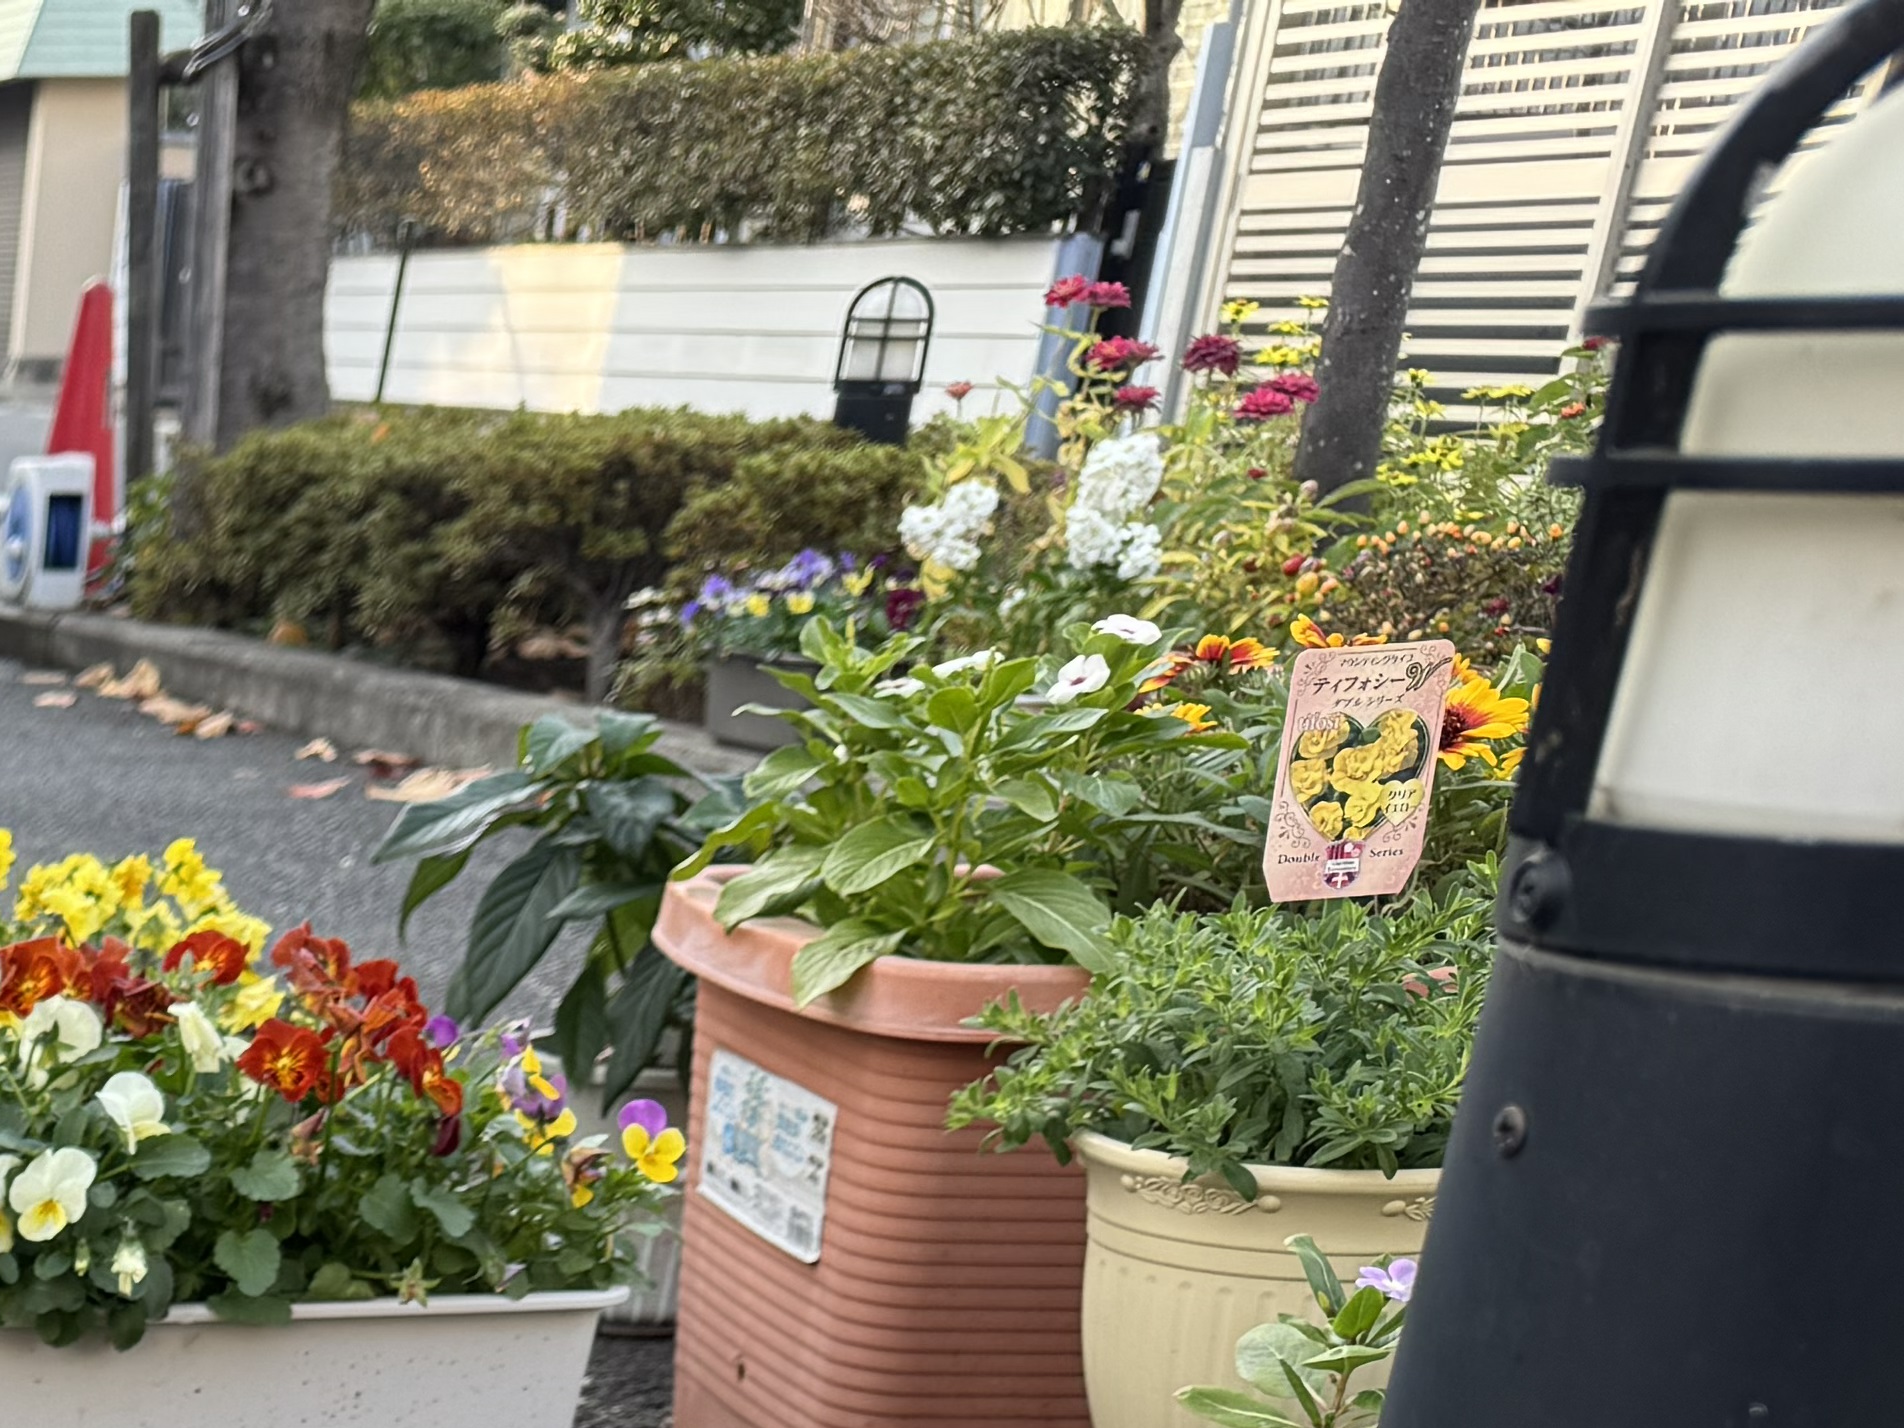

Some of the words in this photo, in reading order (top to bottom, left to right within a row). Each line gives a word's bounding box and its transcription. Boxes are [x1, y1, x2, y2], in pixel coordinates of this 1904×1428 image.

[1388, 789, 1417, 801] クリア
[1277, 851, 1320, 865] Double
[1369, 847, 1404, 858] Series
